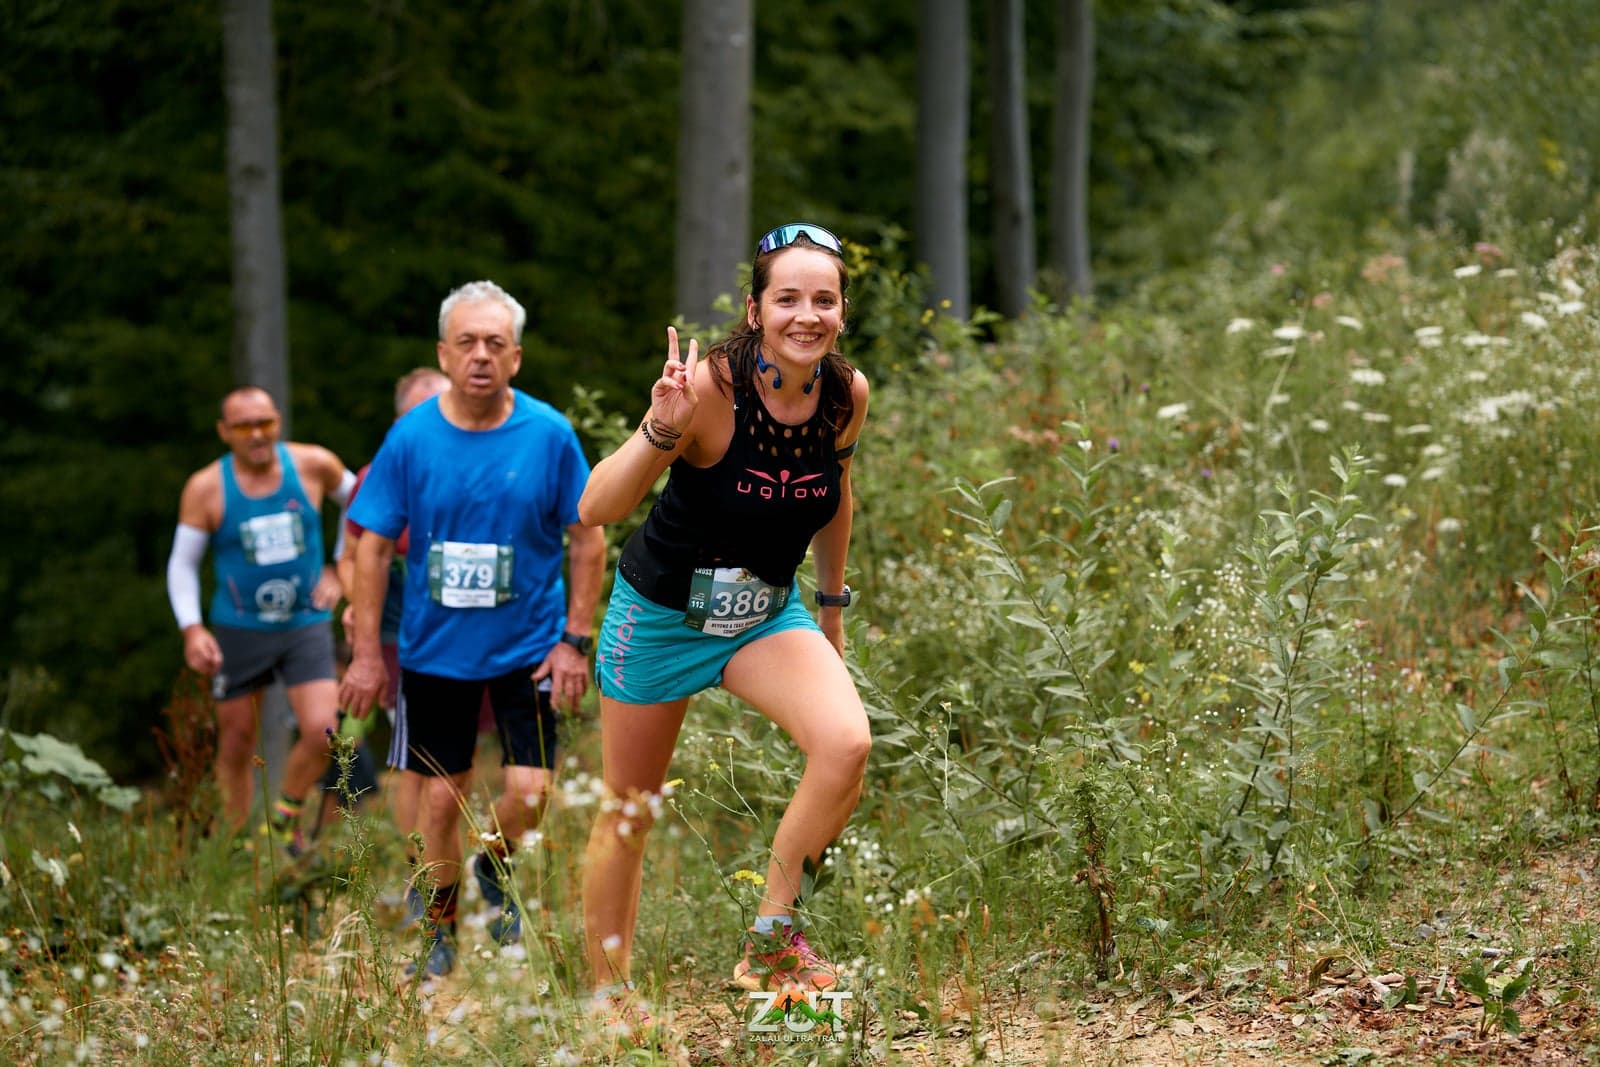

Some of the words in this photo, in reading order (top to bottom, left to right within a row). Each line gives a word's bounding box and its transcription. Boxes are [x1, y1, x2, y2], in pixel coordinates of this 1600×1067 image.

[737, 481, 828, 499] uglow
[445, 562, 494, 589] 379
[691, 600, 705, 609] 112
[713, 587, 771, 617] 386
